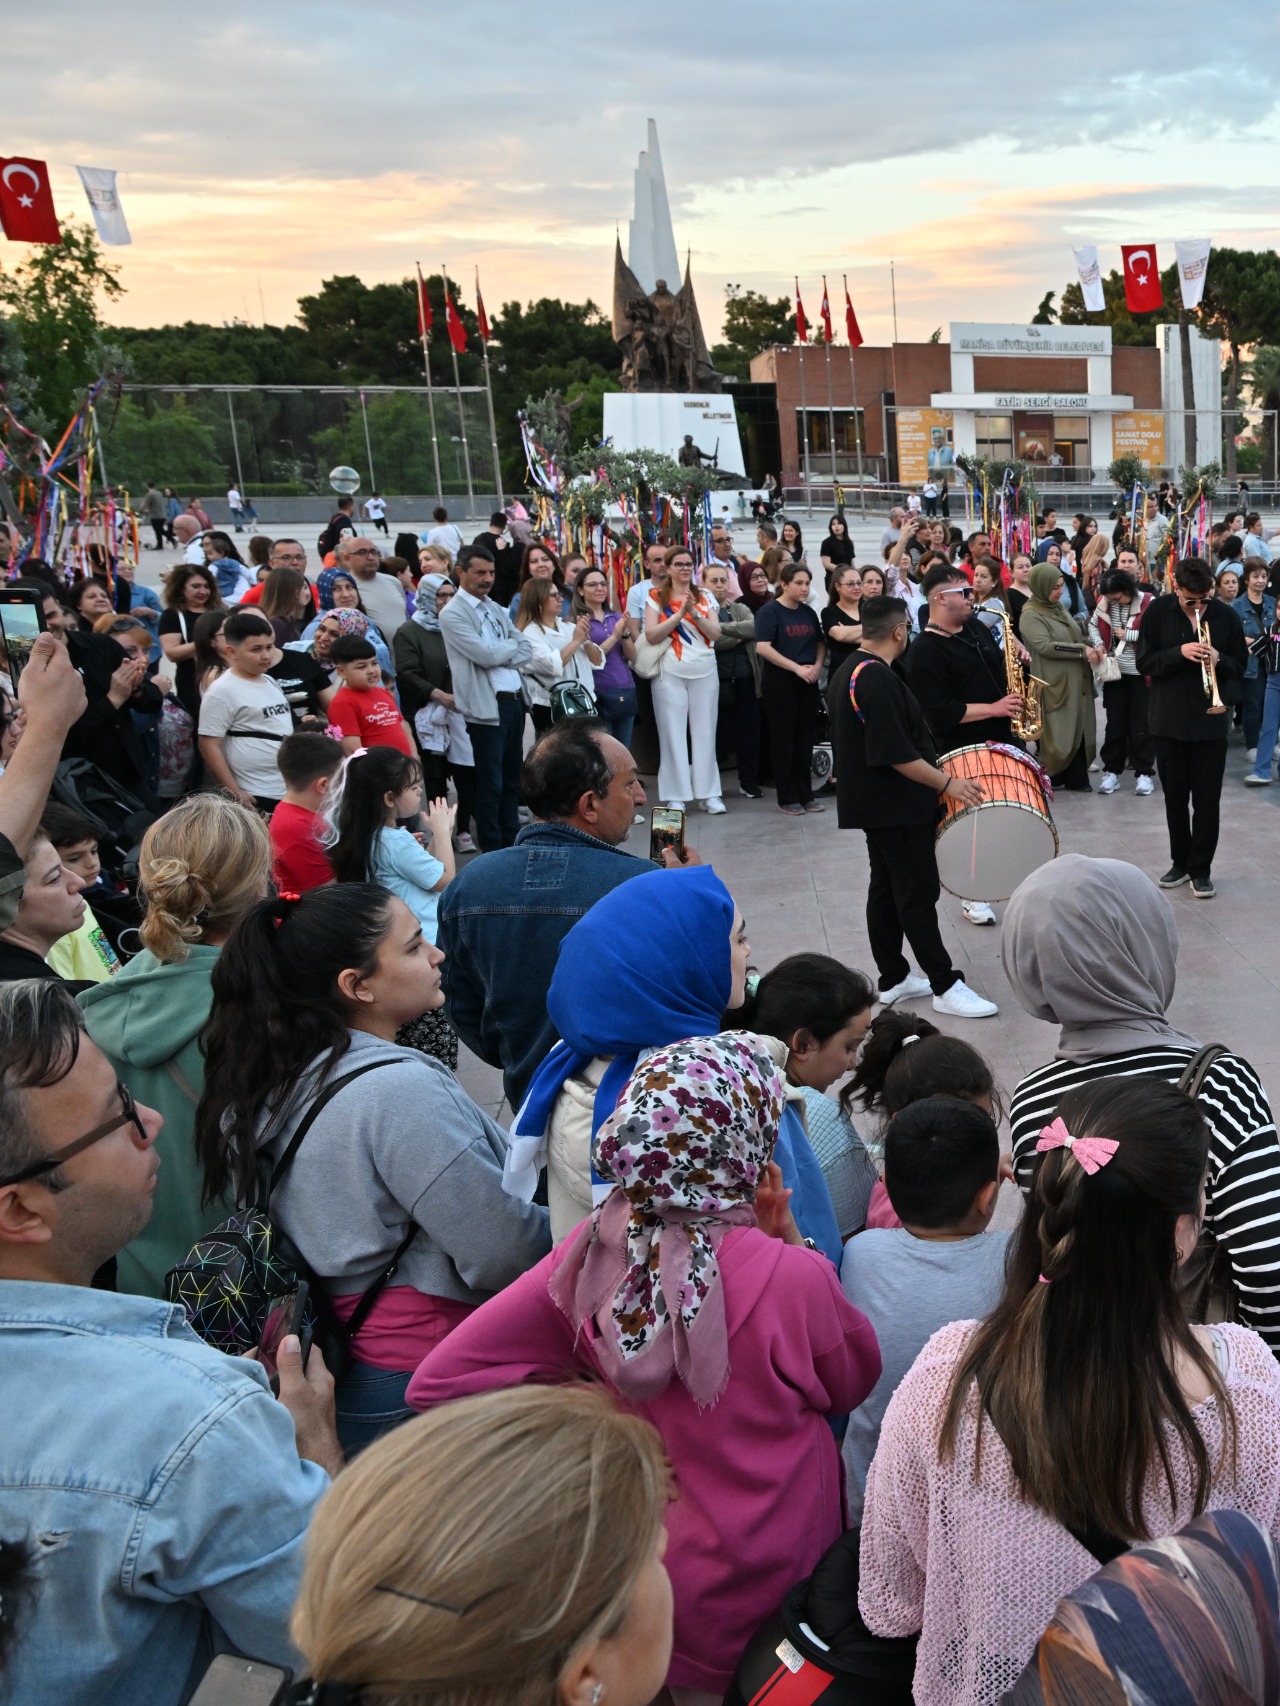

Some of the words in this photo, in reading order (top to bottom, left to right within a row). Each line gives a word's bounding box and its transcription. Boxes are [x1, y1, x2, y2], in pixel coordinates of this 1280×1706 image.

[960, 338, 995, 350] MANİSA
[996, 338, 1053, 352] BÜYÜKŞEHİR
[1055, 340, 1105, 352] BELEDİYESİ
[995, 396, 1022, 407] FATİH
[1023, 396, 1052, 407] SERGİ
[1054, 397, 1088, 408] SALONU
